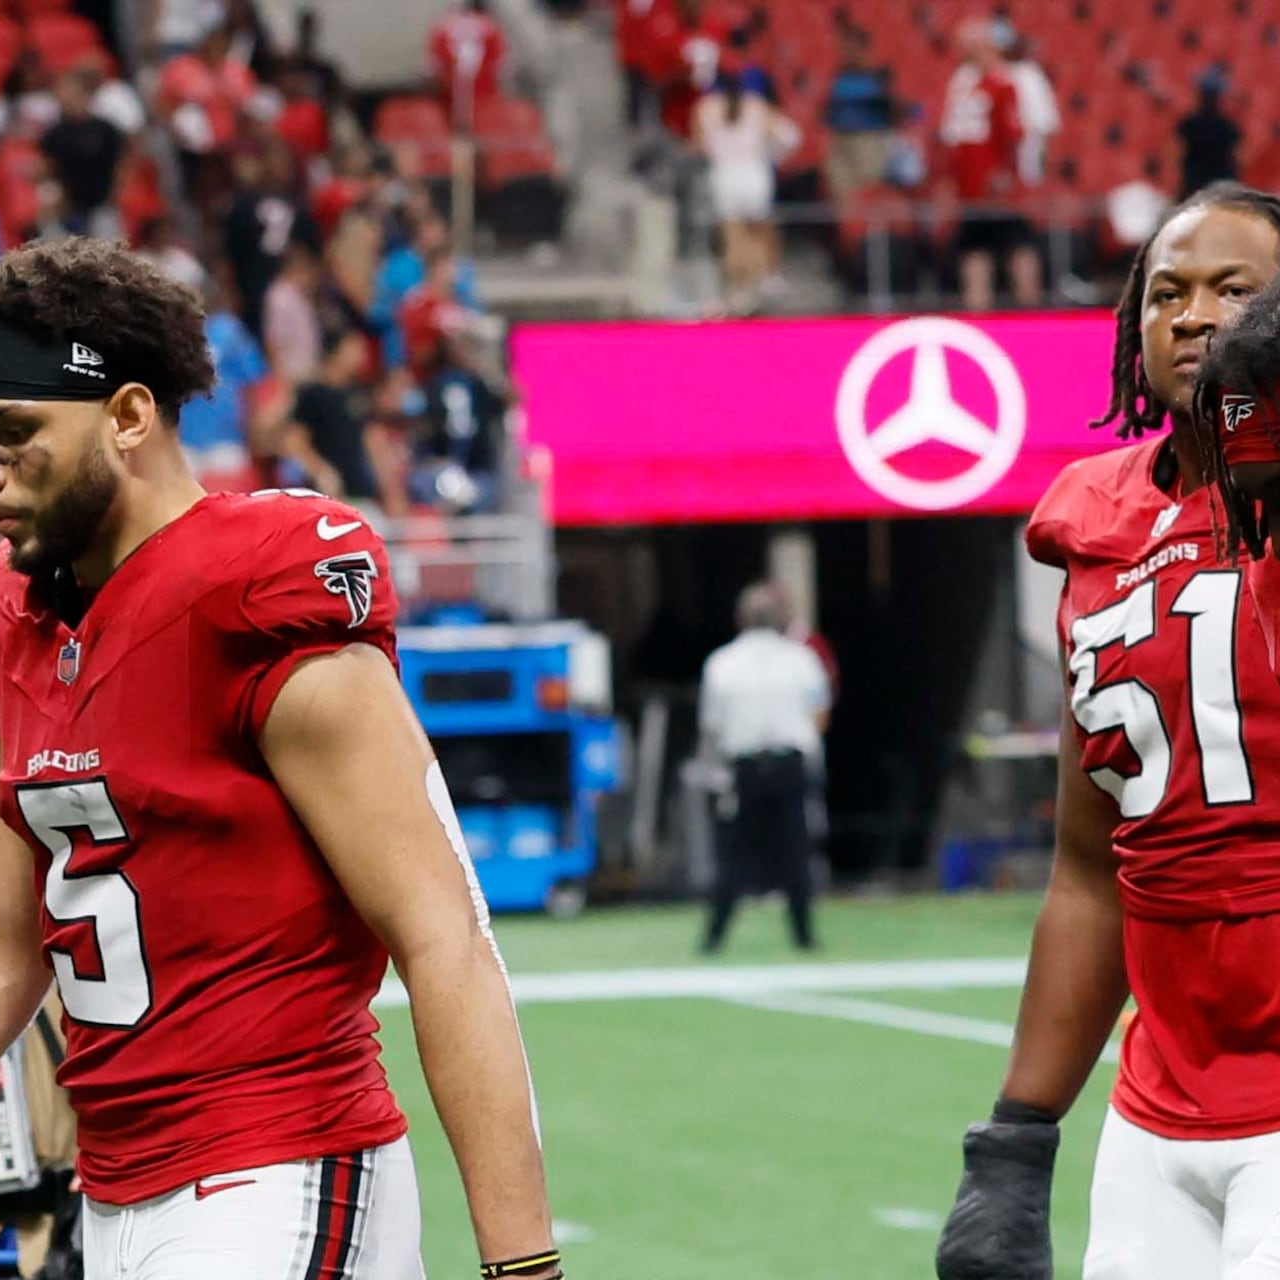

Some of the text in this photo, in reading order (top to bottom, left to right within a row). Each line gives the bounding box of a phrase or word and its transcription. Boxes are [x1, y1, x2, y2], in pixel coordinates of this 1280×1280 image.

[1115, 542, 1199, 591] FALCONS
[27, 748, 100, 777] FALCONS
[1069, 568, 1257, 820] 51
[14, 776, 154, 1030] 5
